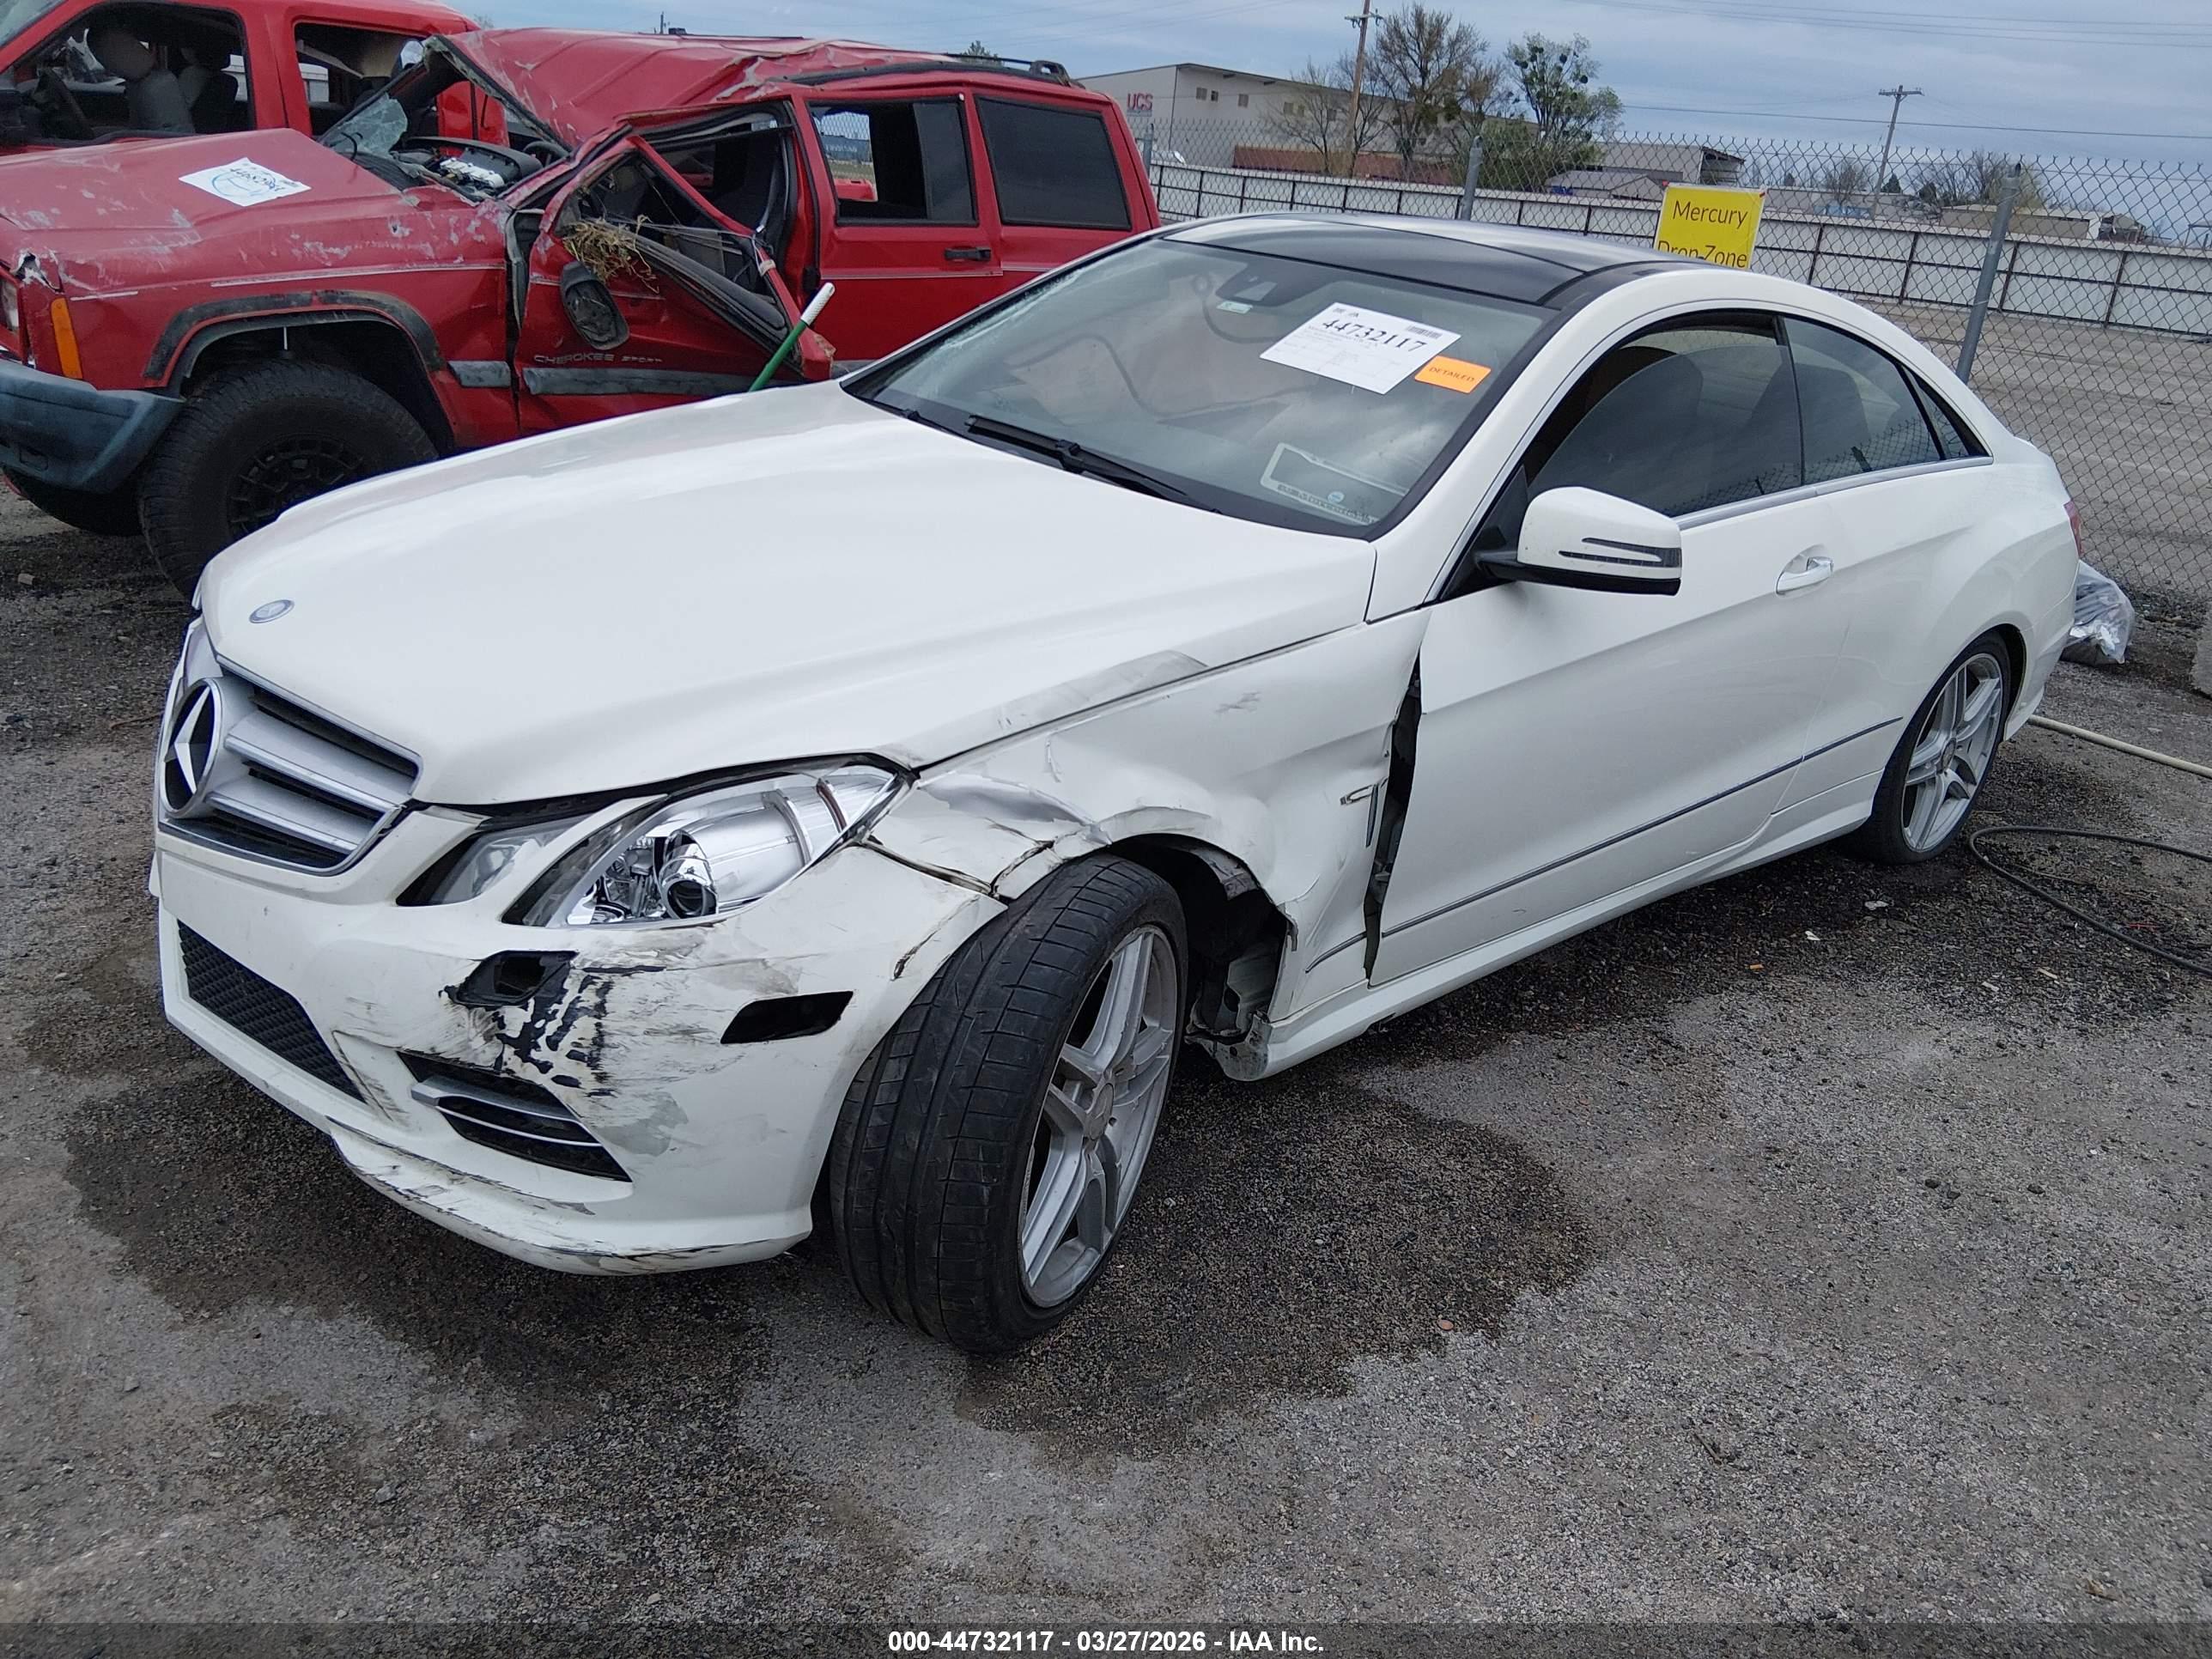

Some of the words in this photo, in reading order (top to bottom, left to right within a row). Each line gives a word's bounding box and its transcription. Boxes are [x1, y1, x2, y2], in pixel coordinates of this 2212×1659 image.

[1127, 93, 1153, 110] UCS
[1673, 200, 1748, 229] Mercury
[1704, 245, 1747, 268] Zone
[1322, 319, 1427, 352] 44732117
[534, 353, 615, 365] CHEROKEE
[1429, 367, 1476, 383] DETAILED
